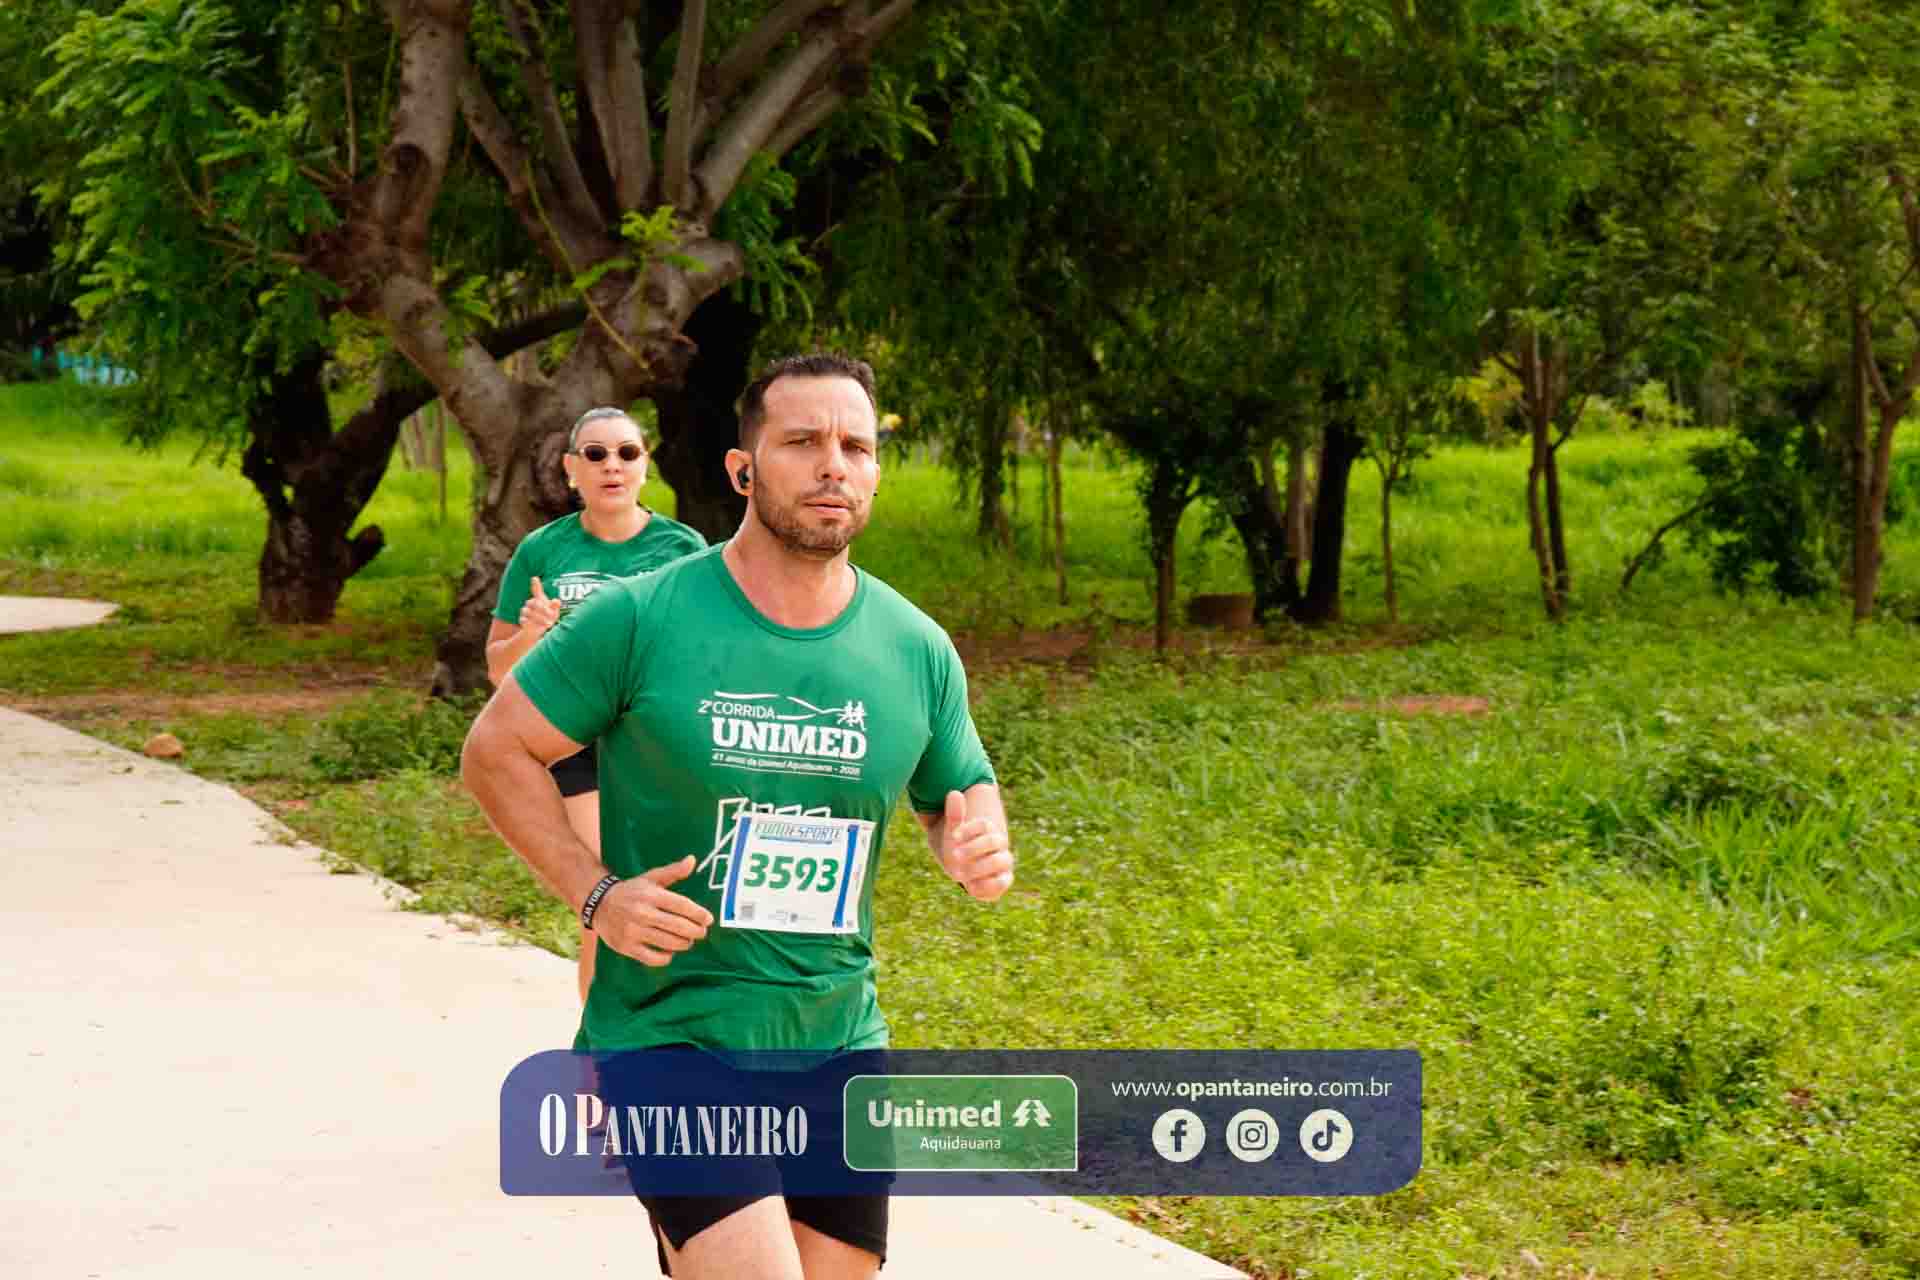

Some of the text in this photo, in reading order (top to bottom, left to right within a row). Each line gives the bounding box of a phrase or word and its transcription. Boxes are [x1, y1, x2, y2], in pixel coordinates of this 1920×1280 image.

[712, 701, 775, 720] CORRIDA
[712, 717, 866, 759] UNIMED
[743, 852, 839, 892] 3593
